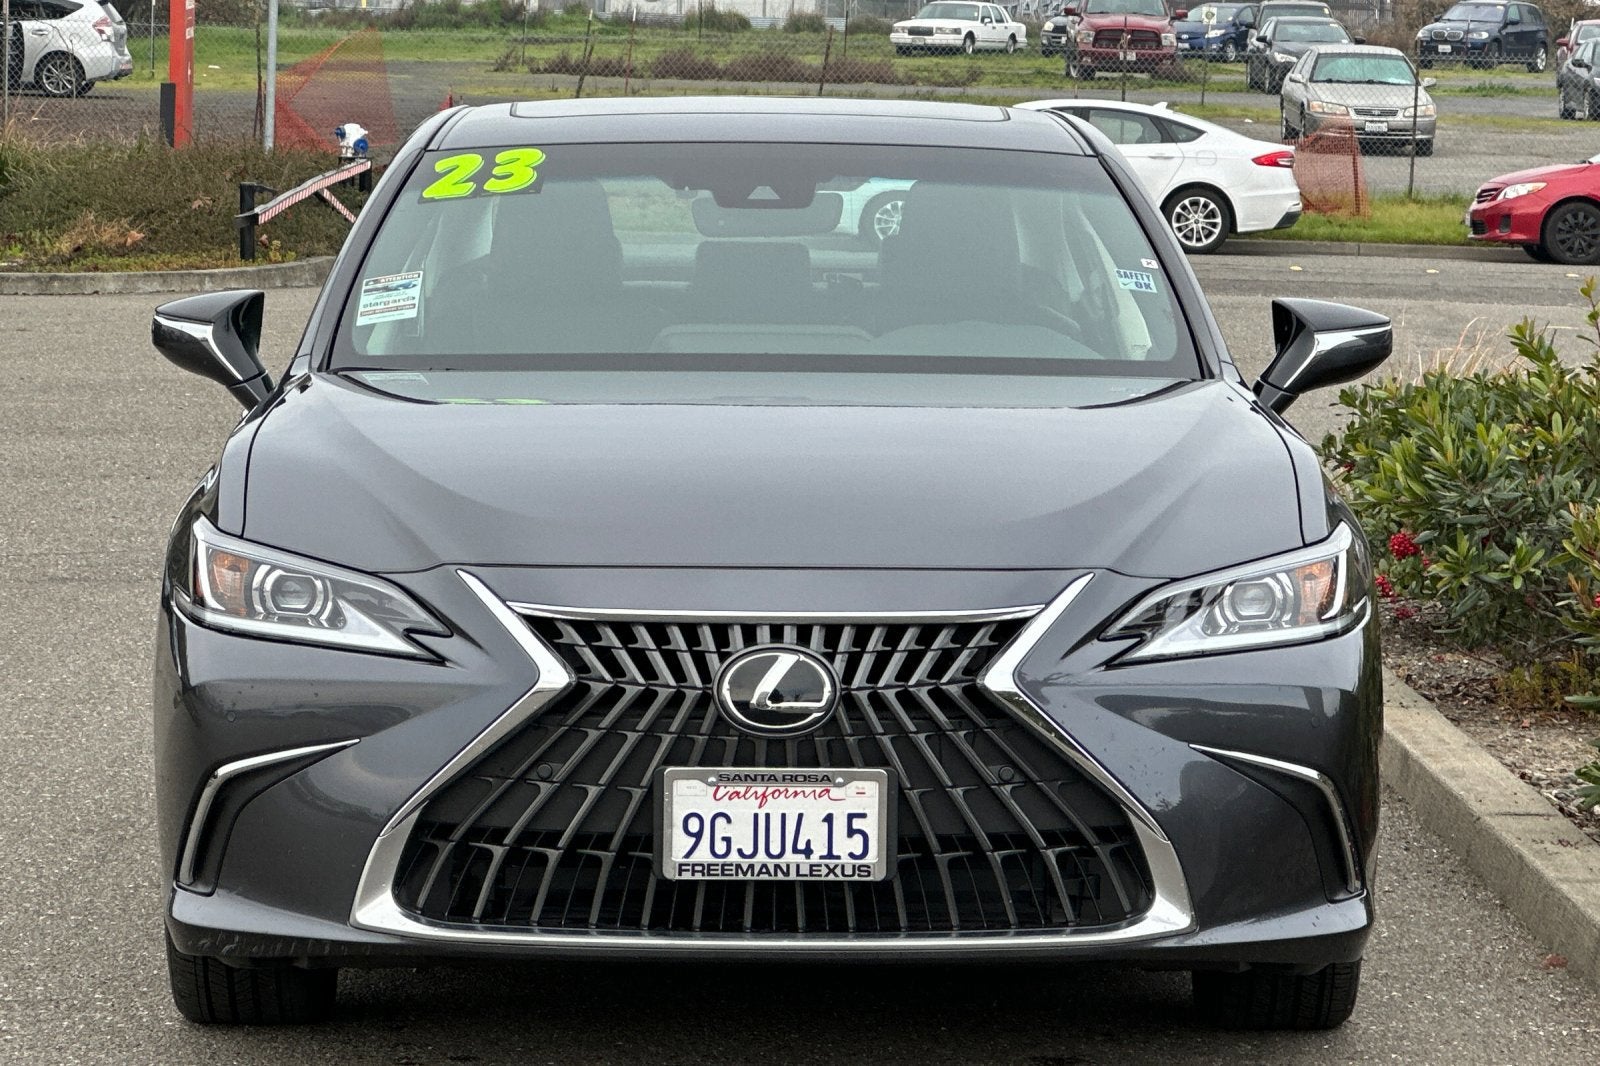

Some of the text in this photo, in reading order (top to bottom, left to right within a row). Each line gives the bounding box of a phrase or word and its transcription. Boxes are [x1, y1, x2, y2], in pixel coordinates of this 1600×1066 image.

[422, 148, 546, 200] 23
[1116, 270, 1151, 282] SAFETY
[1134, 281, 1153, 291] OK
[718, 773, 832, 784] SANTA ROSA
[713, 785, 846, 809] California
[682, 812, 870, 860] 9GJU415
[677, 863, 871, 878] FREEMAN LEXUS
